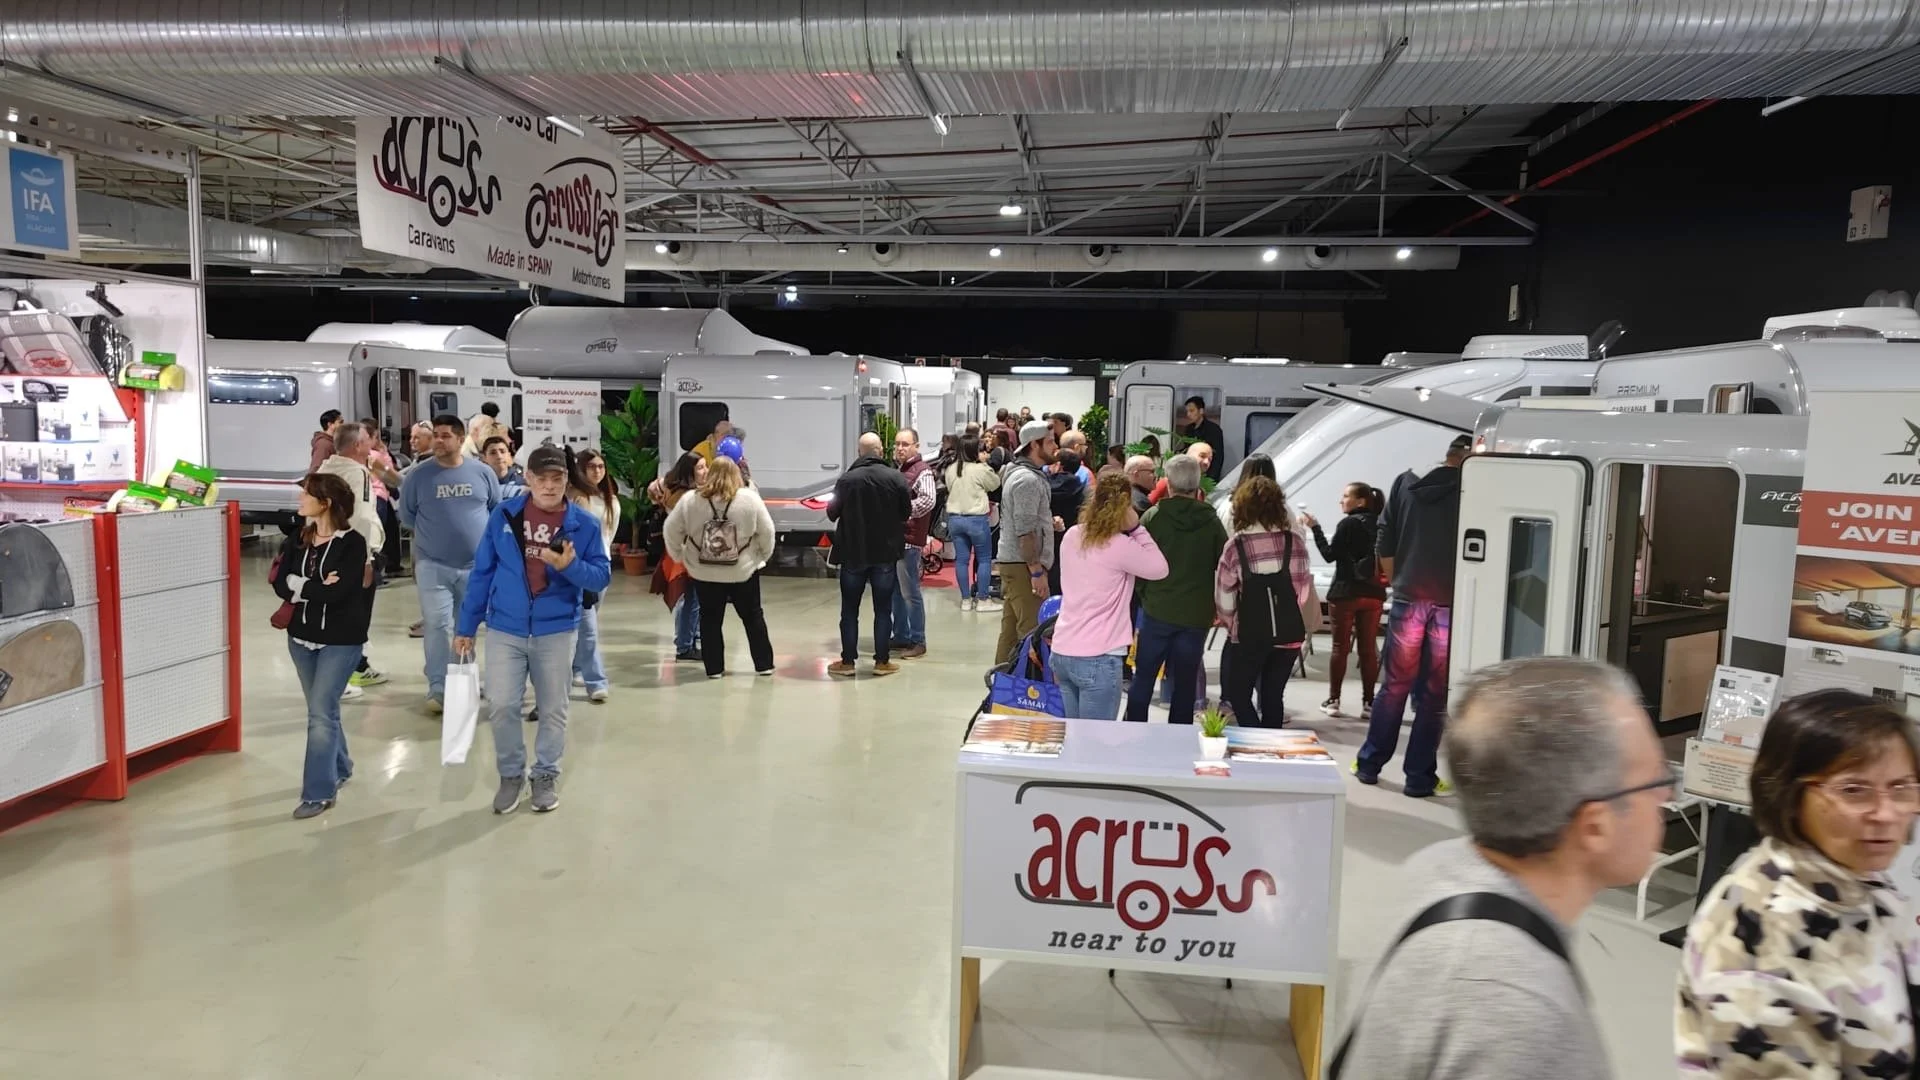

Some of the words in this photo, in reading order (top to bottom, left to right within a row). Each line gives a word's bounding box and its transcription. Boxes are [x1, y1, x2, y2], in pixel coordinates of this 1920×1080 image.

[23, 188, 56, 215] IFA
[407, 224, 455, 254] Caravans
[487, 244, 515, 268] Made
[517, 252, 525, 271] in
[528, 255, 553, 277] SPAIN
[525, 389, 598, 397] AUTOCARAVANAS
[1617, 384, 1660, 394] PREMIUM
[1827, 502, 1912, 521] JOIN
[1017, 697, 1047, 709] SAMAY
[1027, 813, 1277, 931] across
[1048, 930, 1123, 951] near
[1135, 932, 1166, 953] to
[1174, 938, 1236, 961] you
